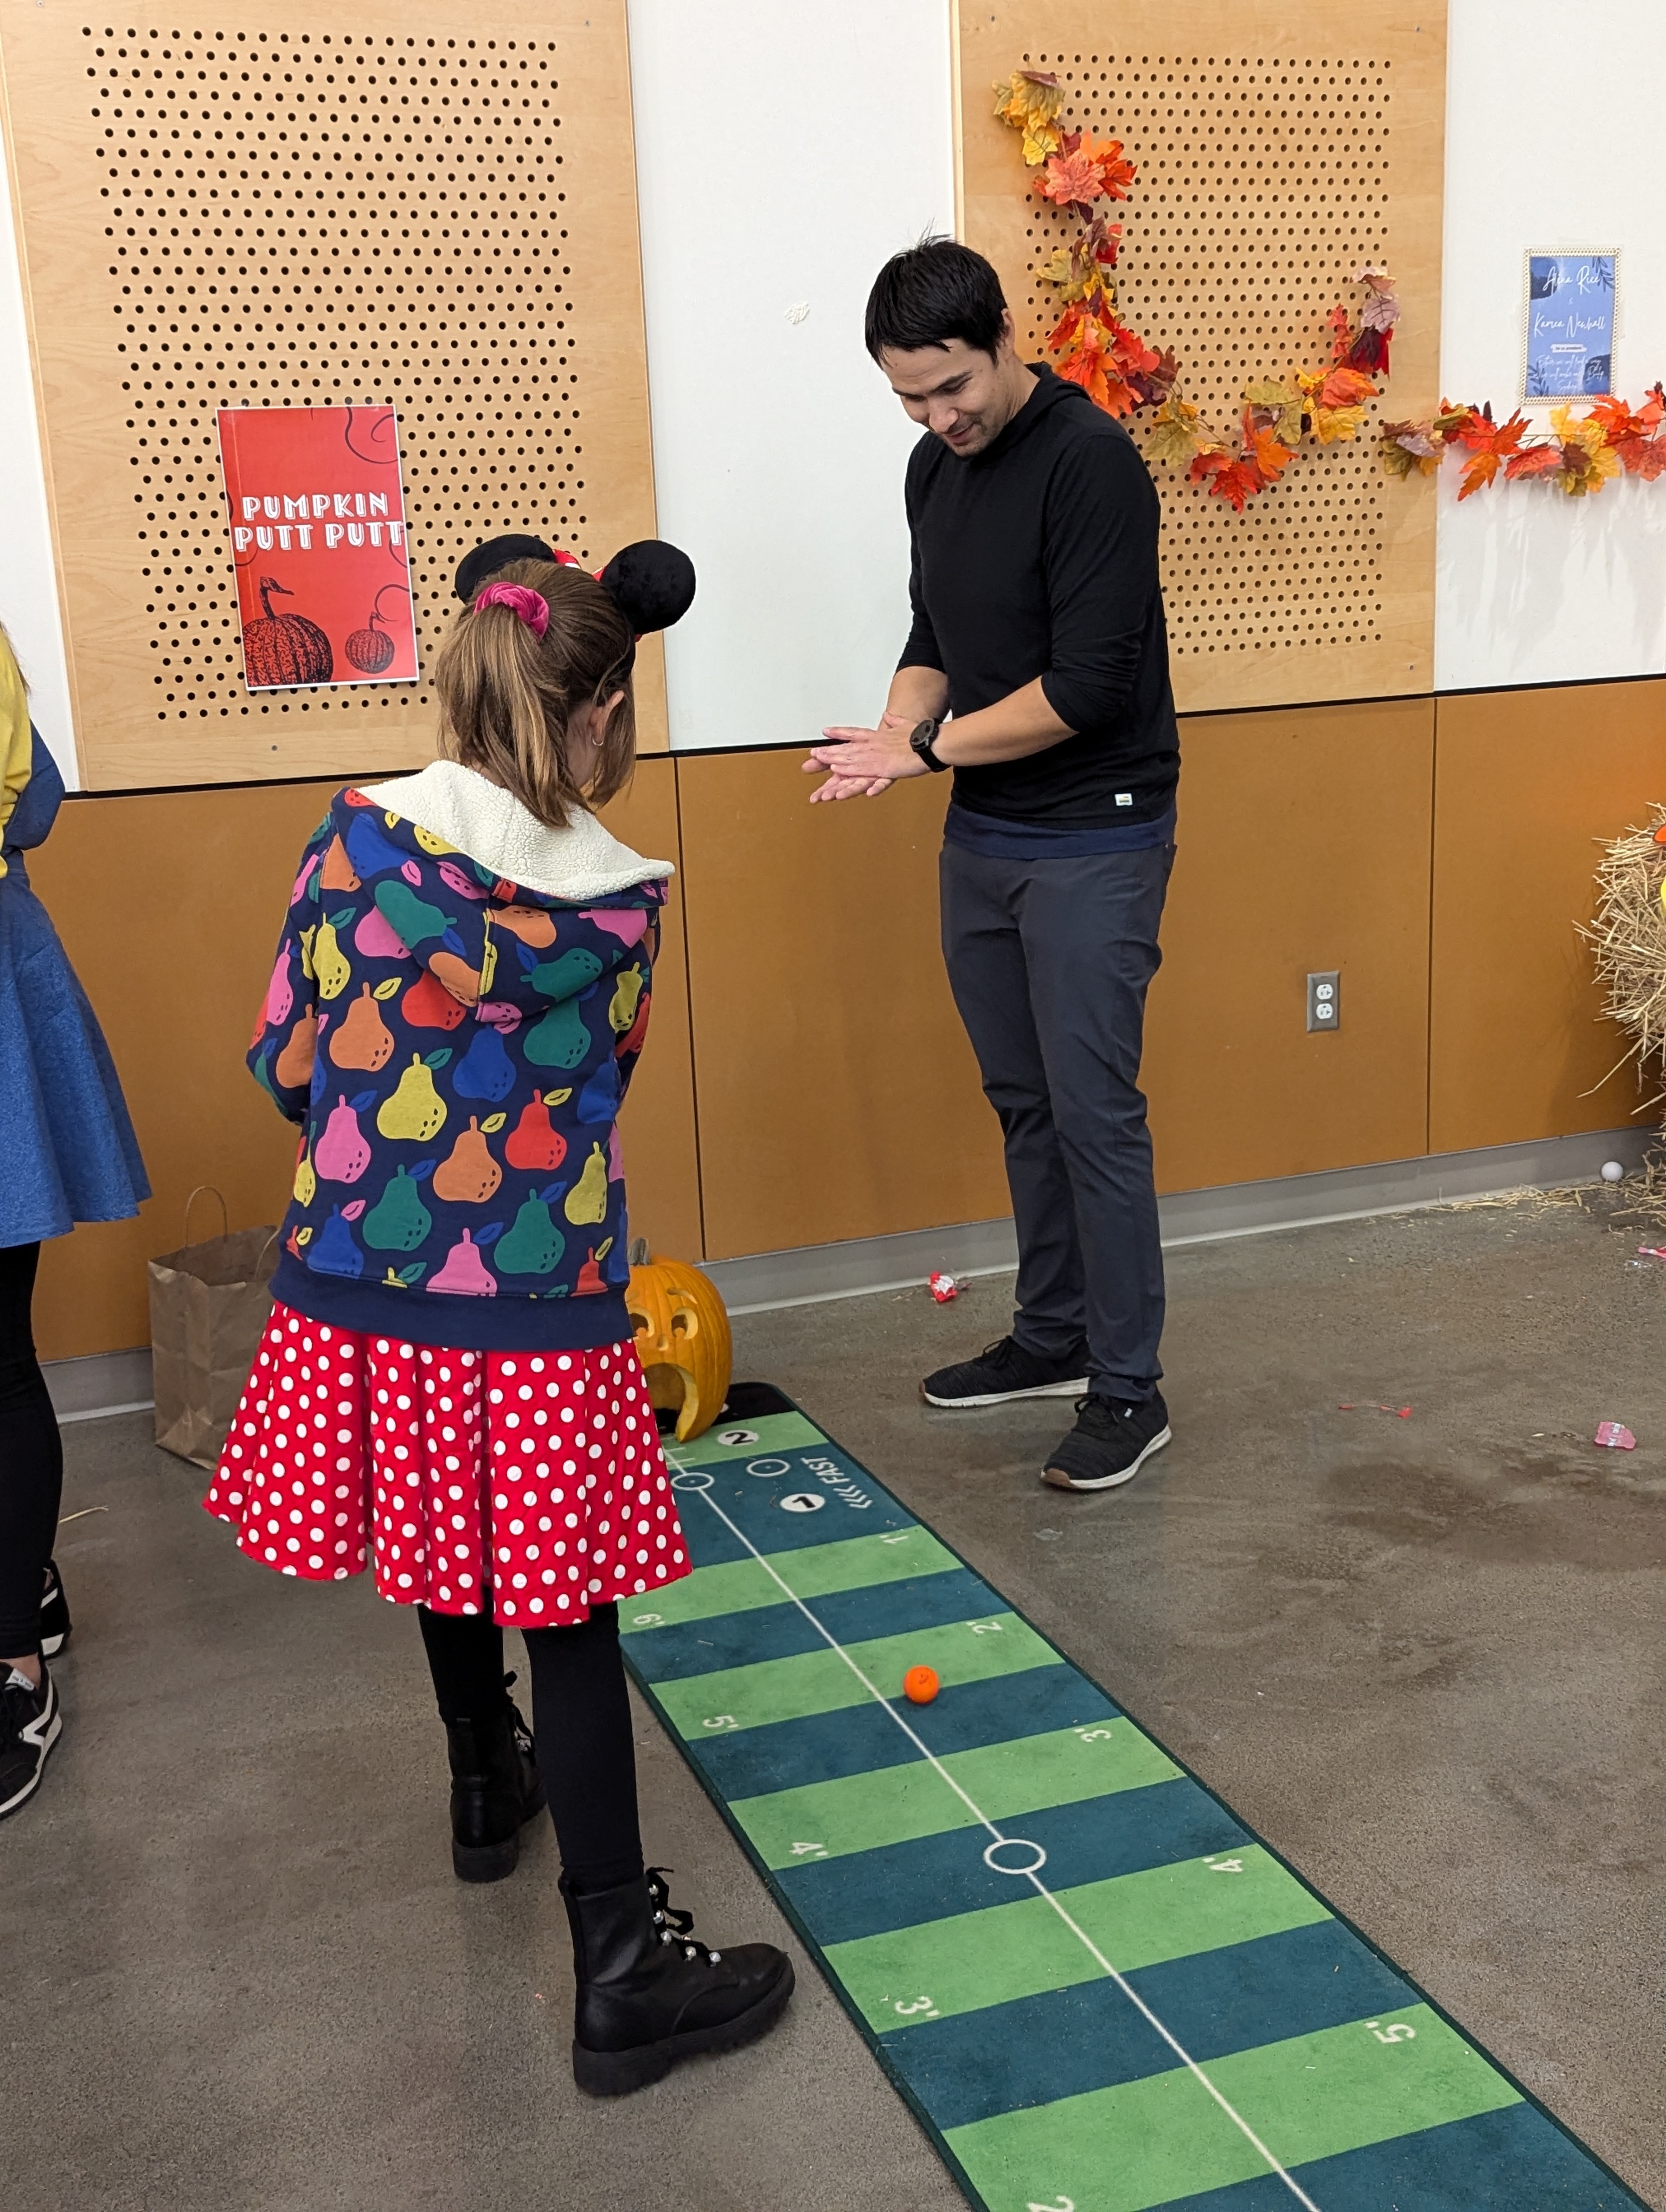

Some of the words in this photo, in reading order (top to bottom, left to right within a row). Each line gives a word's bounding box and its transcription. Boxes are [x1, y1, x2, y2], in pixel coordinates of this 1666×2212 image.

[242, 491, 388, 521] PUMPKIN
[234, 524, 313, 552] PUTT
[325, 521, 403, 549] PUTT
[725, 1432, 754, 1445] 2
[800, 1457, 851, 1484] FAST
[792, 1496, 816, 1508] 1
